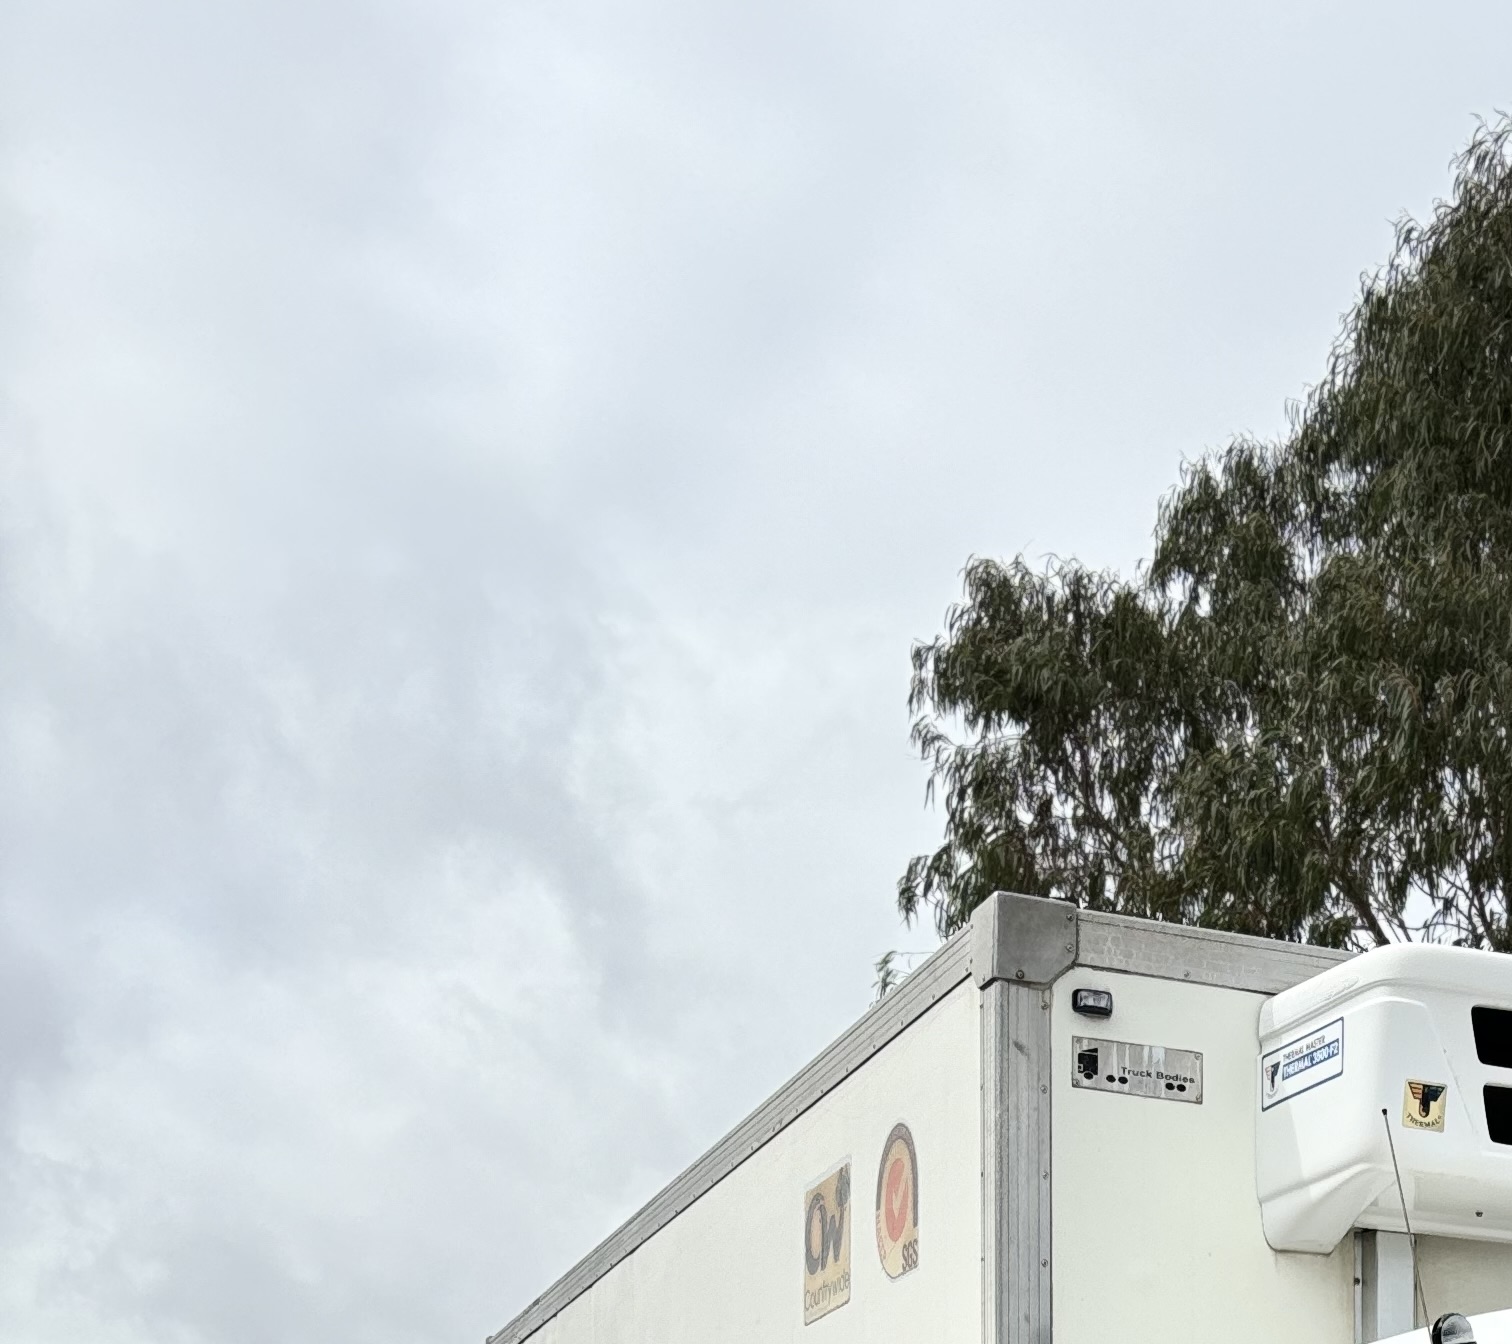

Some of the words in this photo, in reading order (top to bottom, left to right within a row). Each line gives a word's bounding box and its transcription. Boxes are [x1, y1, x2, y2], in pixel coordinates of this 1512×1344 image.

[1121, 1066, 1152, 1079] Truck
[1156, 1071, 1195, 1084] Bodies
[1405, 1112, 1440, 1128] THERMAL
[901, 1238, 919, 1272] SGS
